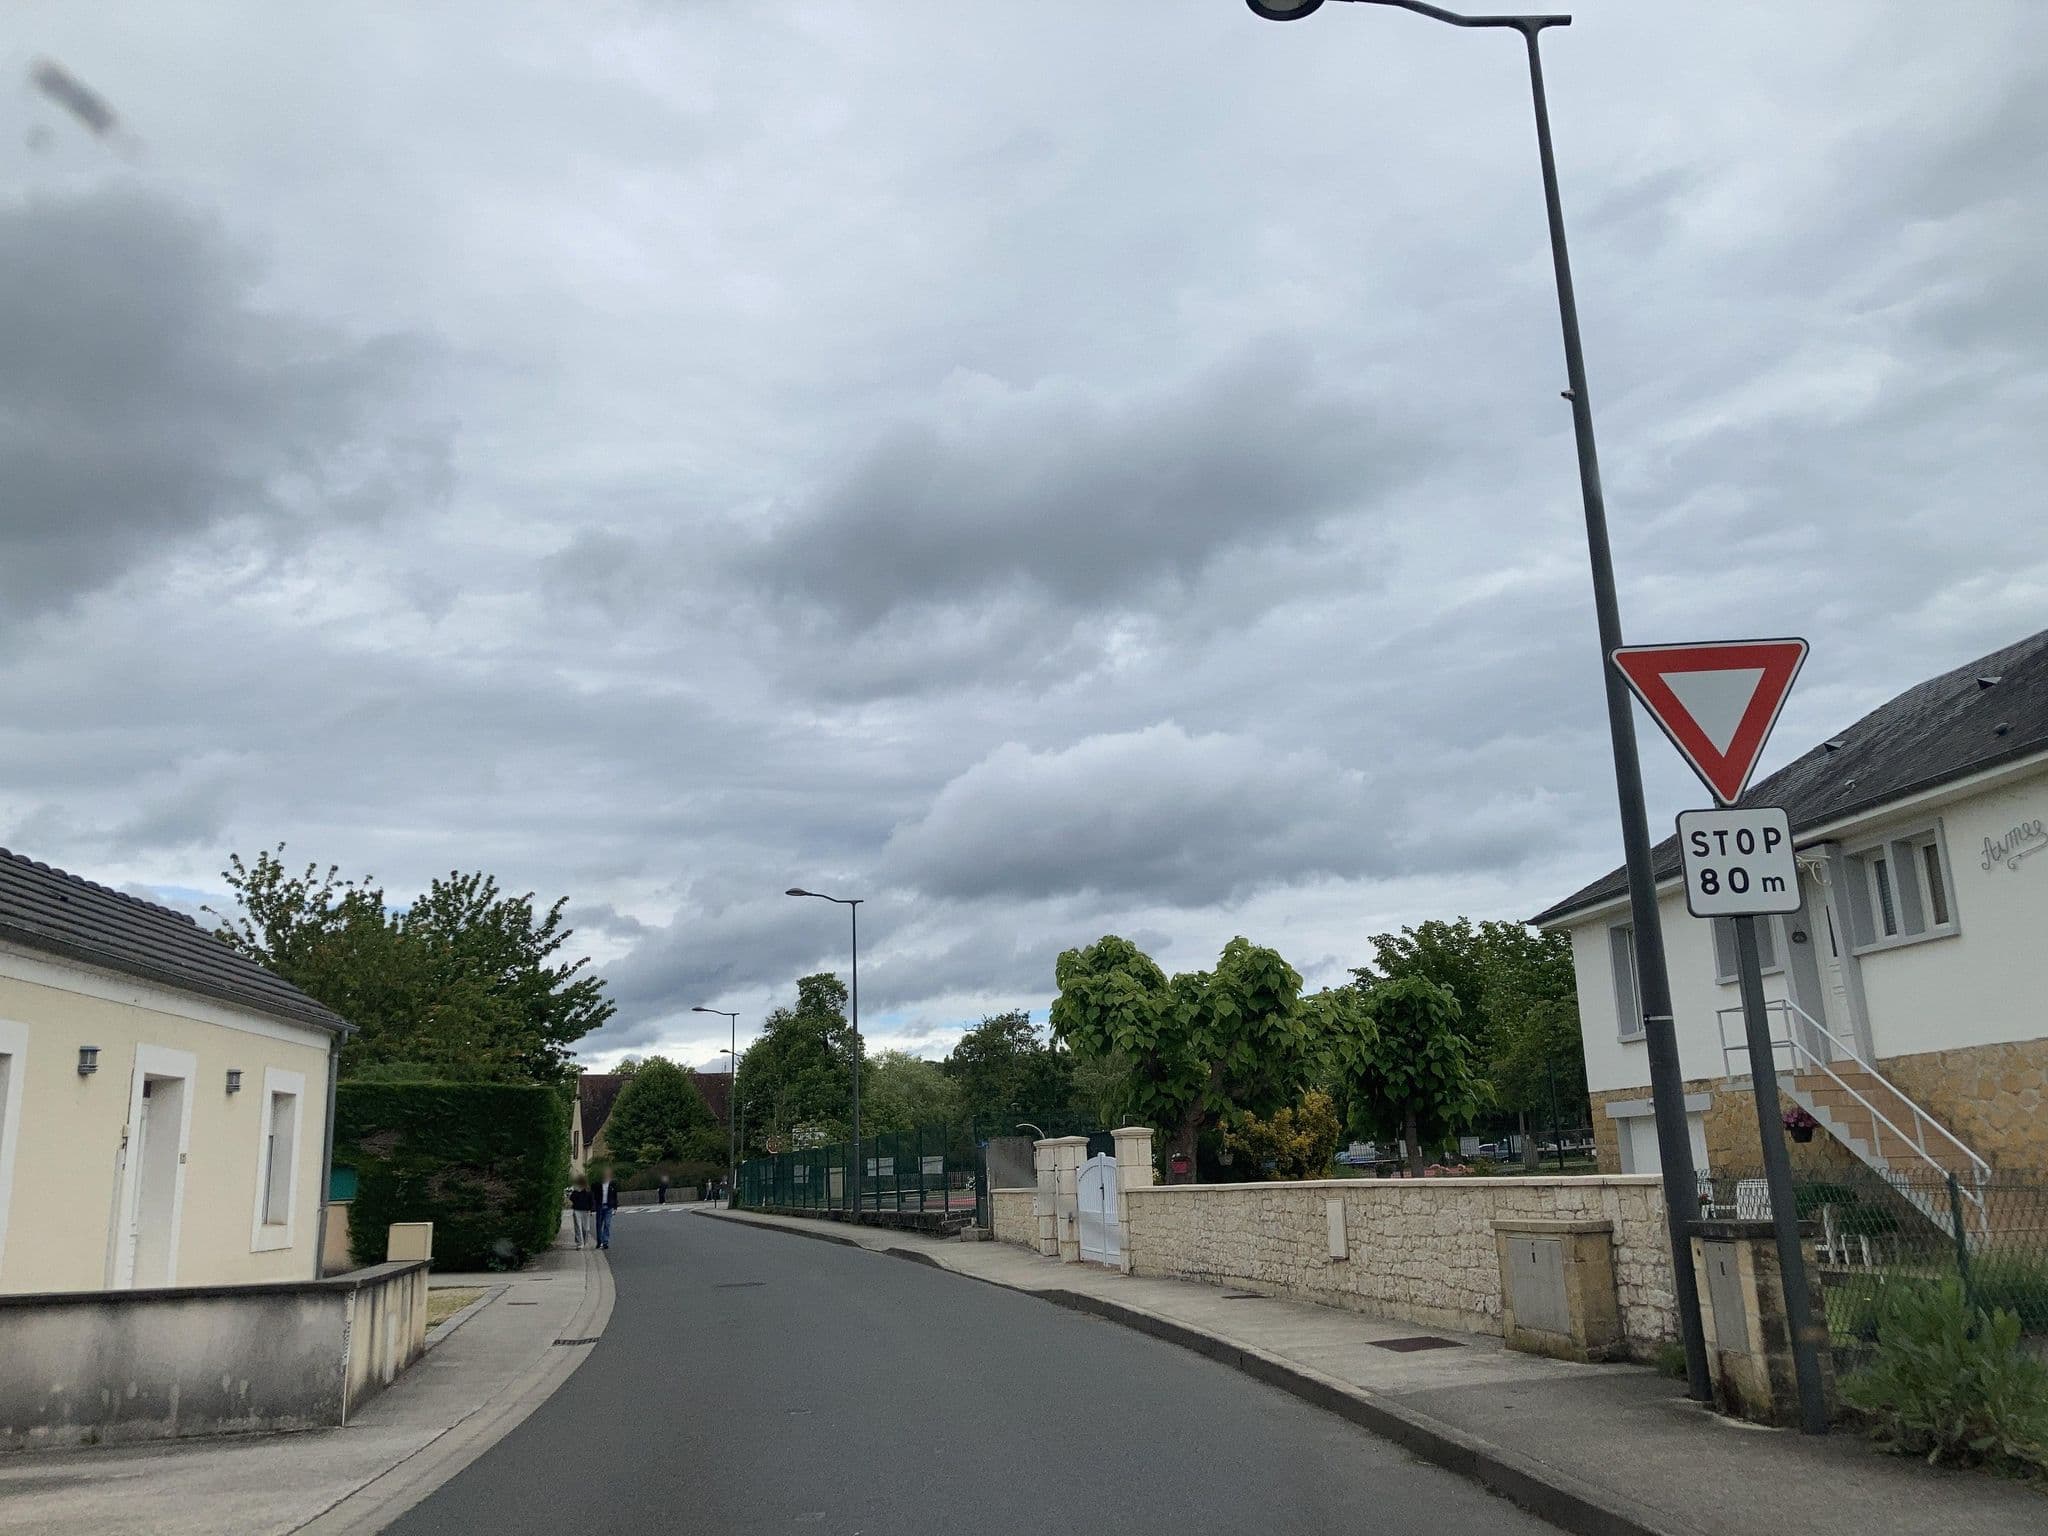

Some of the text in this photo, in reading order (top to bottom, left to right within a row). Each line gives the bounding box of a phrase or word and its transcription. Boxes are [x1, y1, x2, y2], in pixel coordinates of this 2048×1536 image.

[1691, 827, 1782, 857] STOP
[1700, 867, 1785, 895] 80 m
